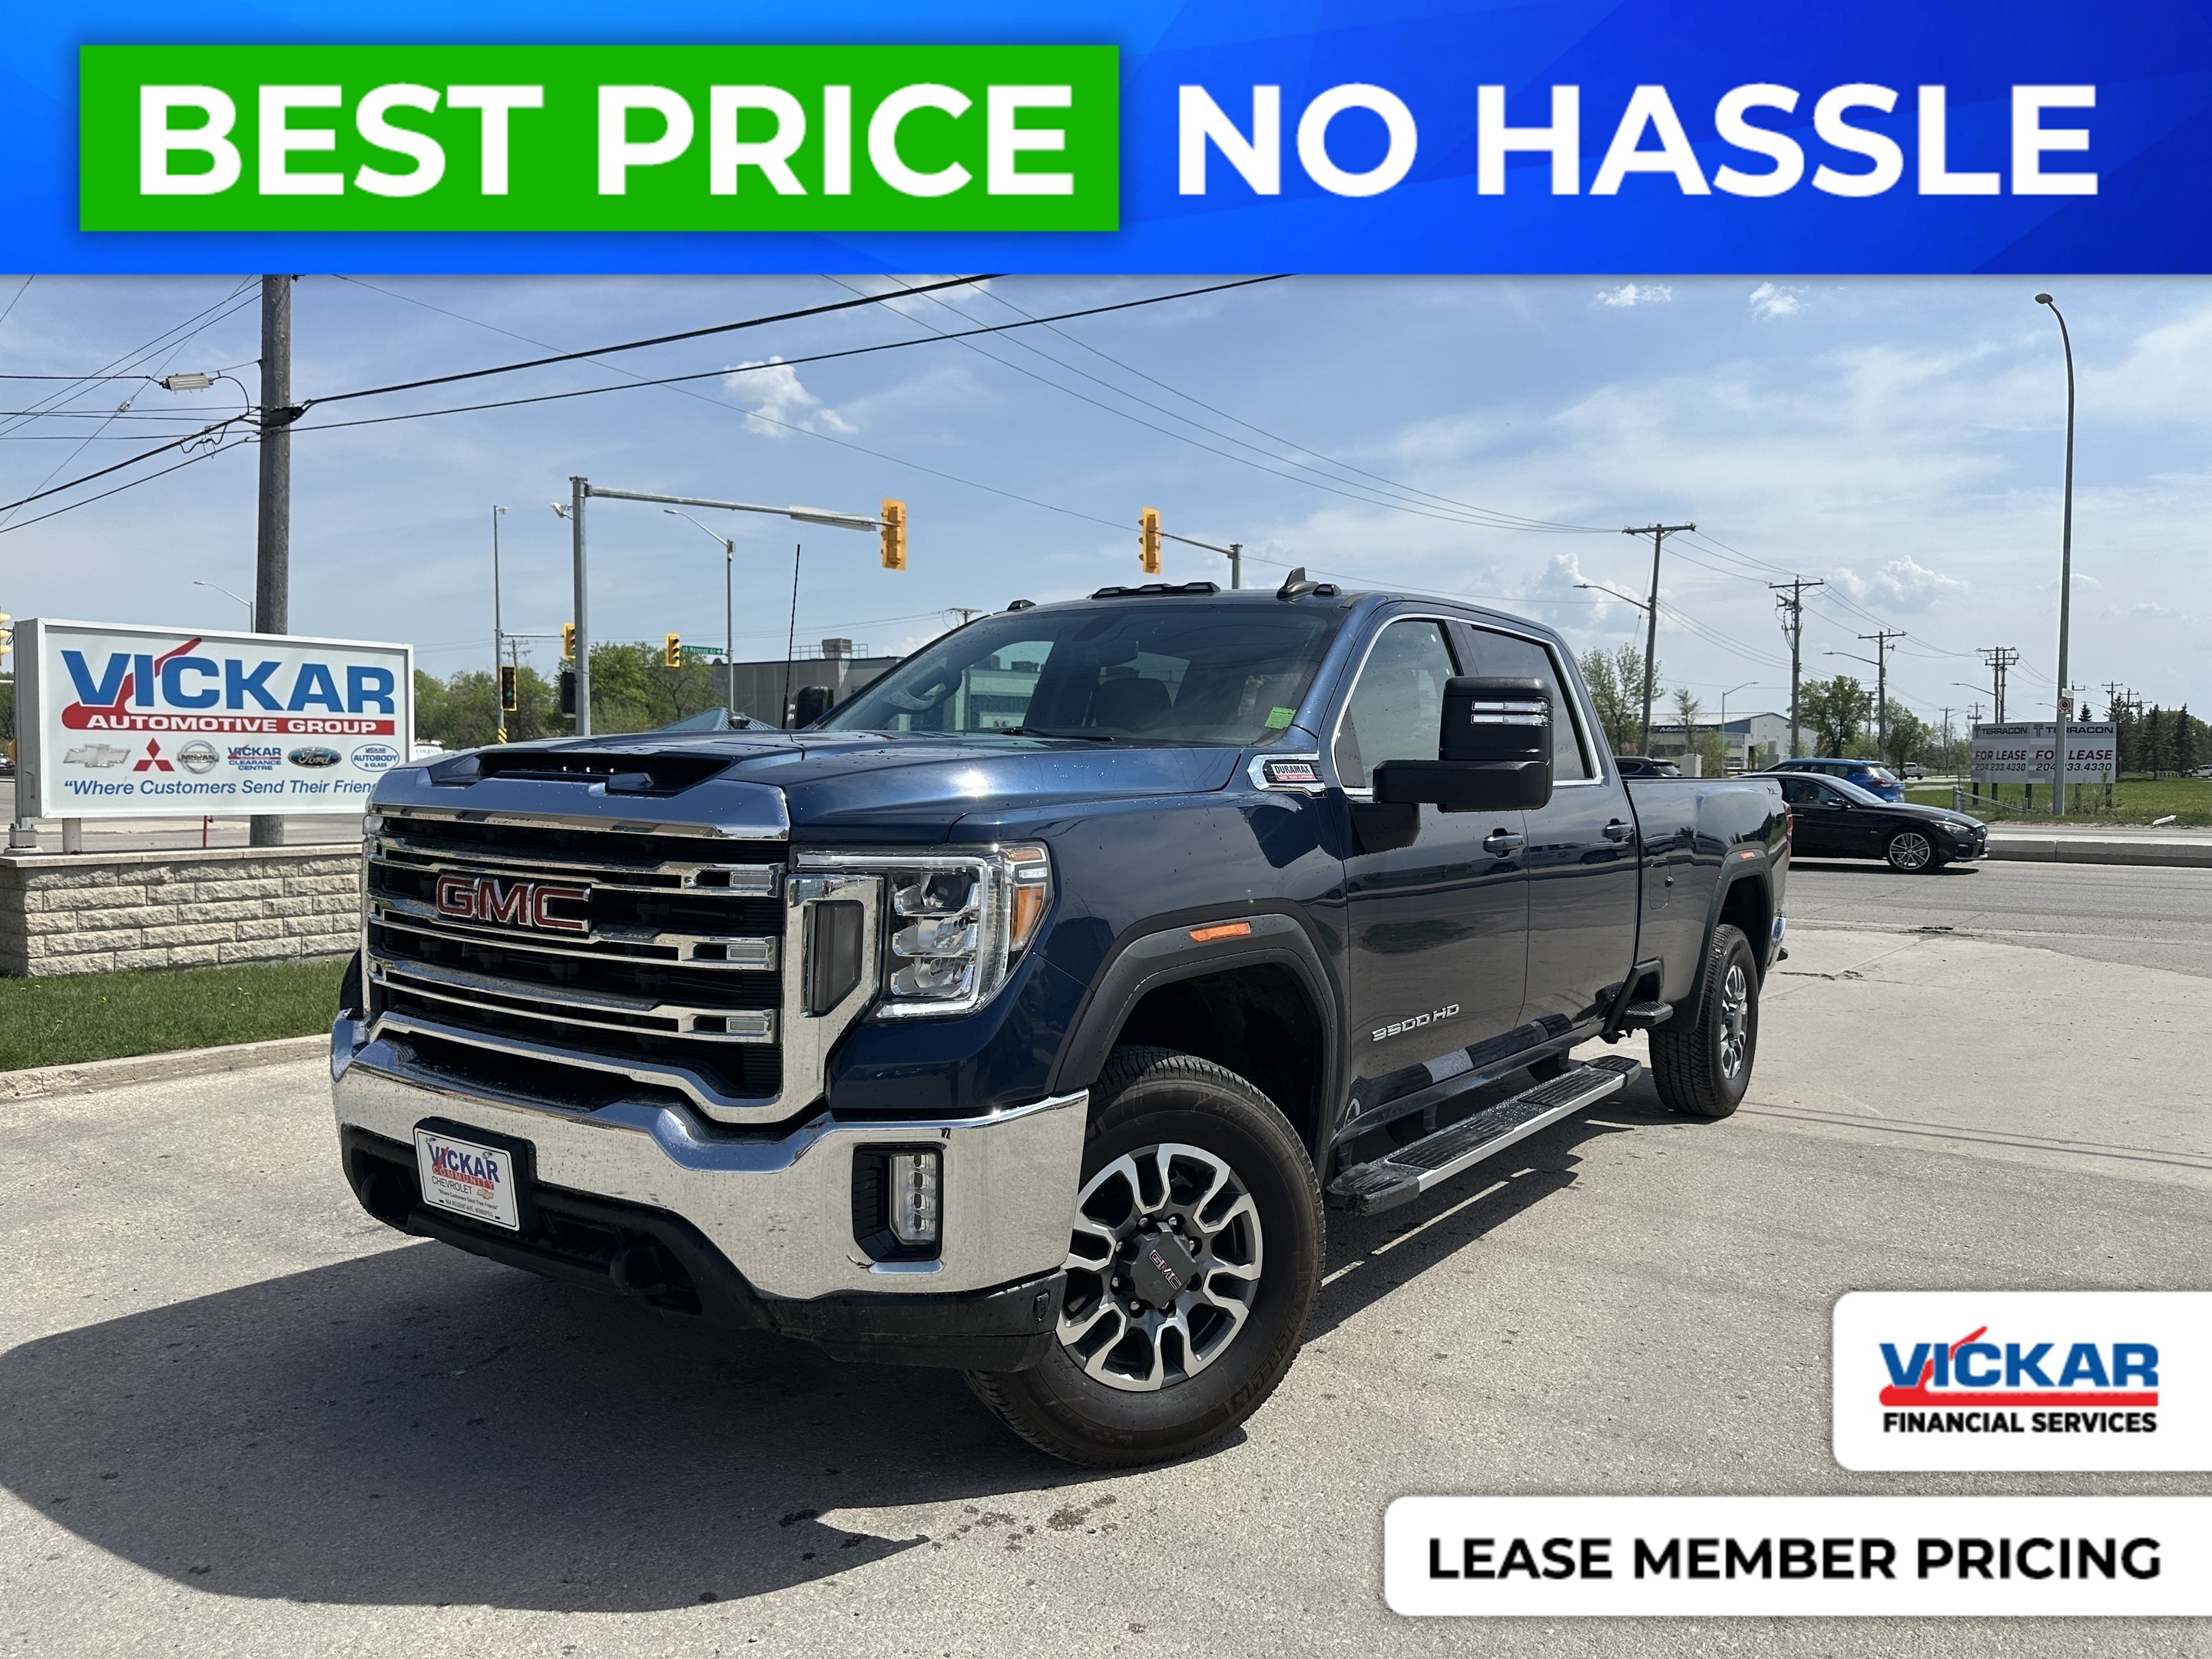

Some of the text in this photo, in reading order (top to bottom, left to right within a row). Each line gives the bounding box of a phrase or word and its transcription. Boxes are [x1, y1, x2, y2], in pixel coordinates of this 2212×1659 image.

[61, 650, 395, 714] VICKAR
[88, 715, 377, 734] AUTOMOTIVE GROUP
[228, 747, 281, 756] VICKAR
[298, 750, 331, 764] Ford
[1975, 750, 2027, 760] FOR LEASE
[2035, 750, 2113, 760] FO LEASE
[1274, 765, 1311, 773] DURAMAX
[2036, 763, 2112, 771] 20433.4330
[141, 780, 236, 794] Customers
[242, 780, 284, 793] Send
[290, 780, 329, 793] Their
[436, 875, 591, 933] GMC
[1372, 1004, 1459, 1041] 3500 HD
[428, 1143, 500, 1183] VICKAR
[432, 1176, 472, 1194] CHEVROLET
[433, 1166, 493, 1189] COMMUNITY
[1149, 1249, 1182, 1290] GMC
